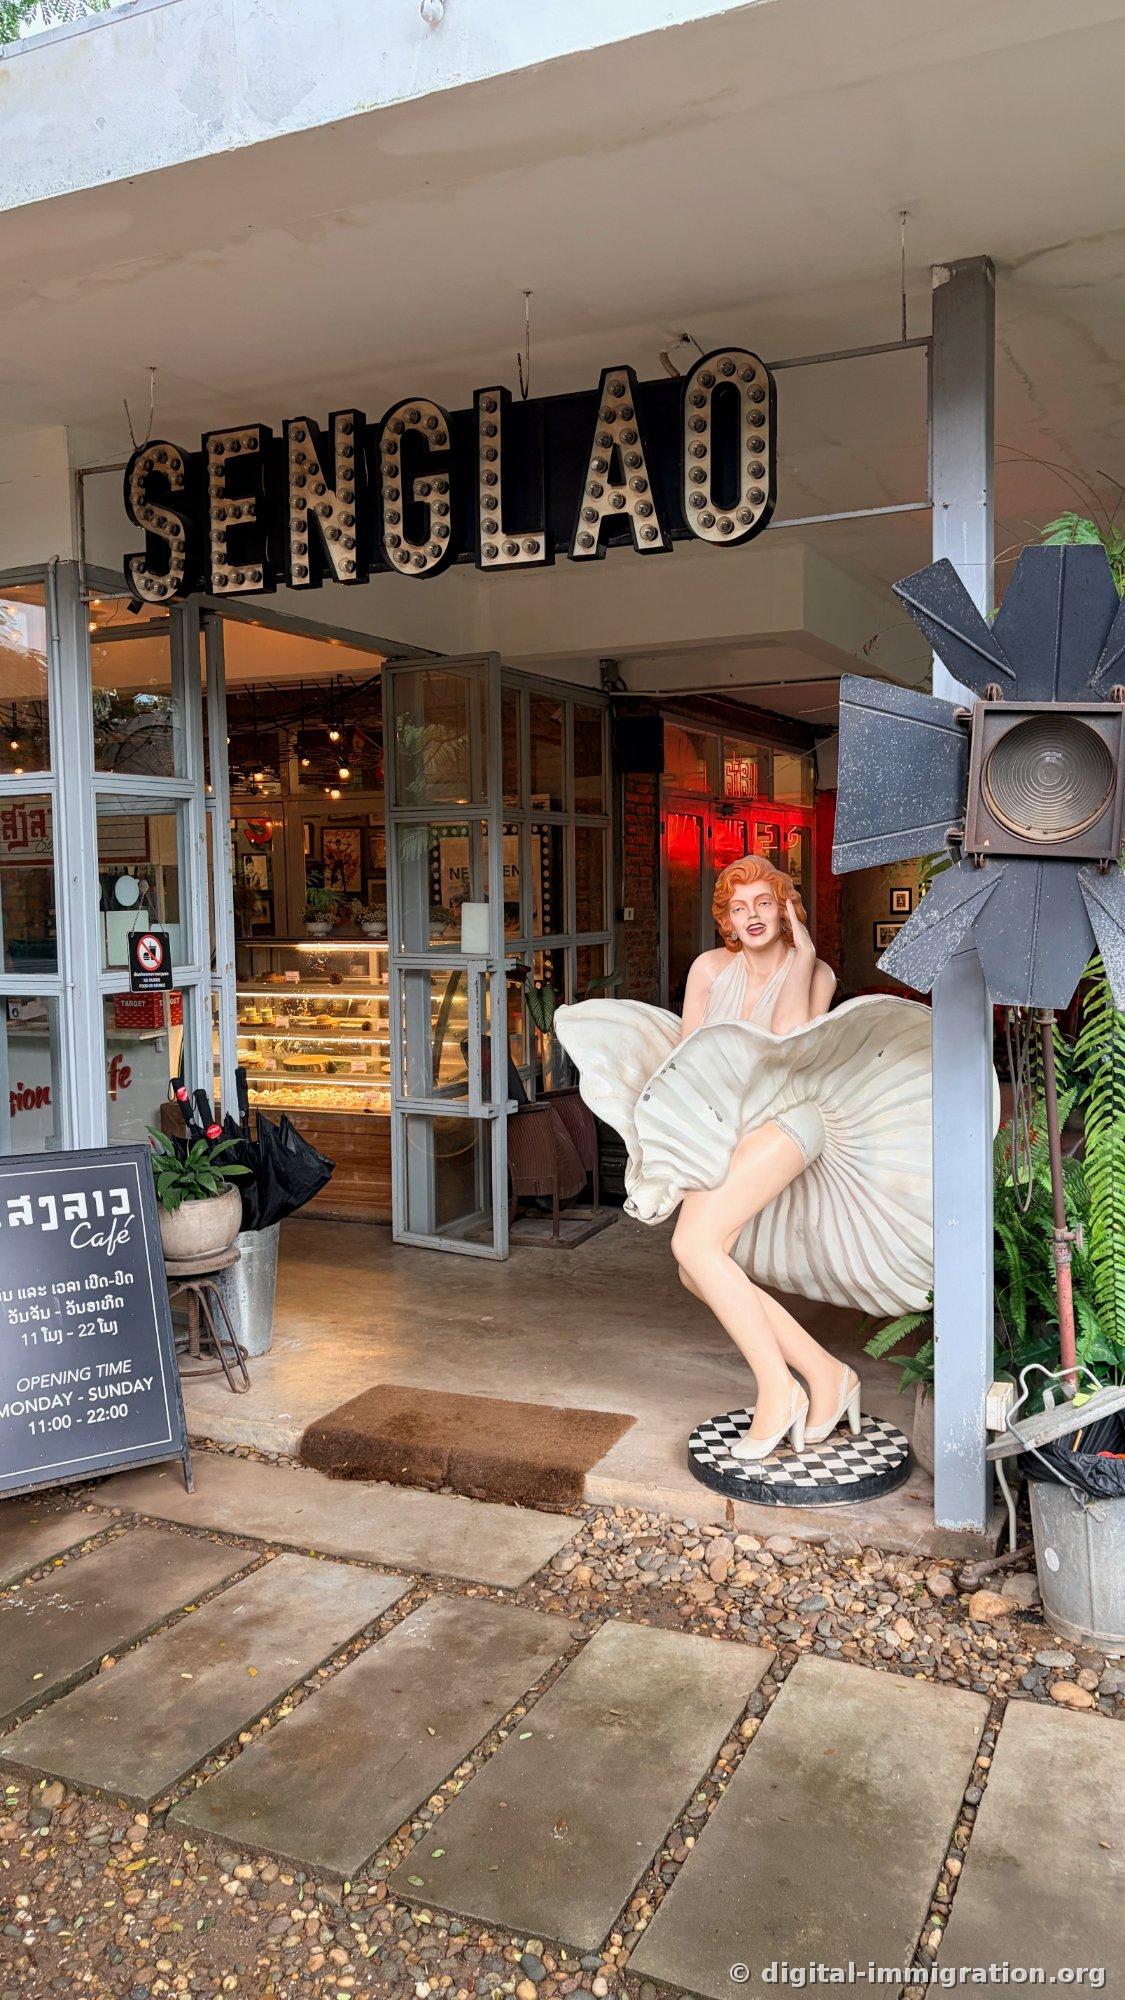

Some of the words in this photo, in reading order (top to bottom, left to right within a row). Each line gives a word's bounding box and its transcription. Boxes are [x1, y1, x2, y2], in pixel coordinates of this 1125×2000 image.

[123, 346, 777, 603] SENGLAO
[70, 1214, 135, 1256] Café
[21, 1331, 37, 1347] 11
[78, 1322, 96, 1337] 22
[16, 1366, 91, 1393] OPENING
[95, 1359, 132, 1378] TIME
[0, 1391, 73, 1418] MONDAY
[88, 1376, 154, 1402] SUNDAY
[28, 1414, 72, 1435] 11:00
[86, 1403, 128, 1424] 22:00
